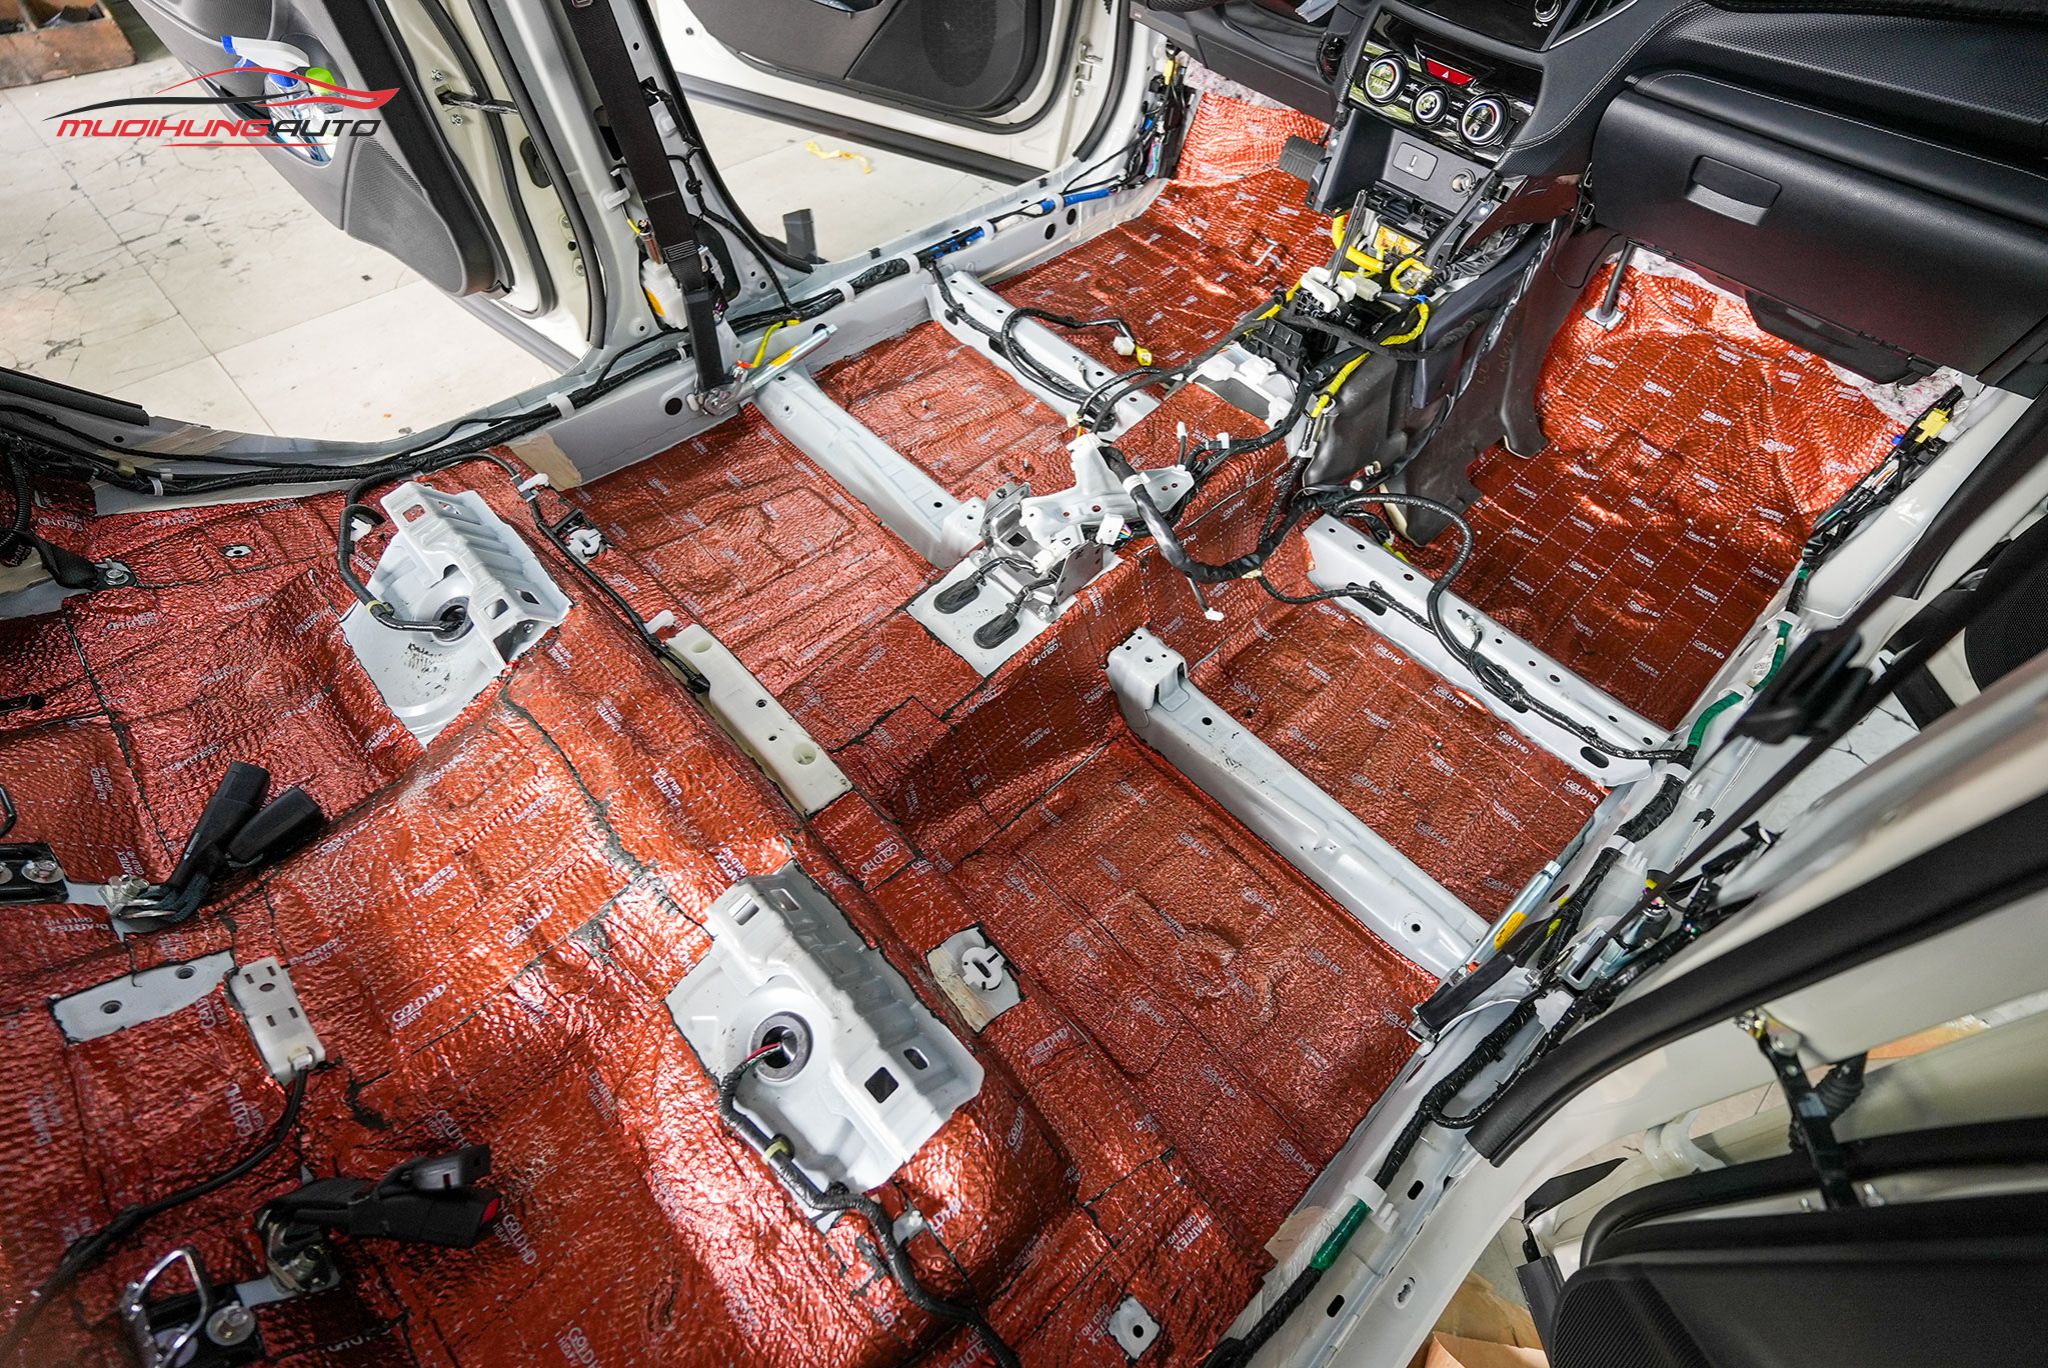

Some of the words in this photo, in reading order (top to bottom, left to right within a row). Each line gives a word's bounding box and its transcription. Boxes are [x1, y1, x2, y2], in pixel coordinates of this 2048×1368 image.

[505, 918, 537, 942] GOLD
[535, 905, 553, 923] HD
[392, 996, 428, 1023] GOLD
[425, 983, 447, 1003] HD
